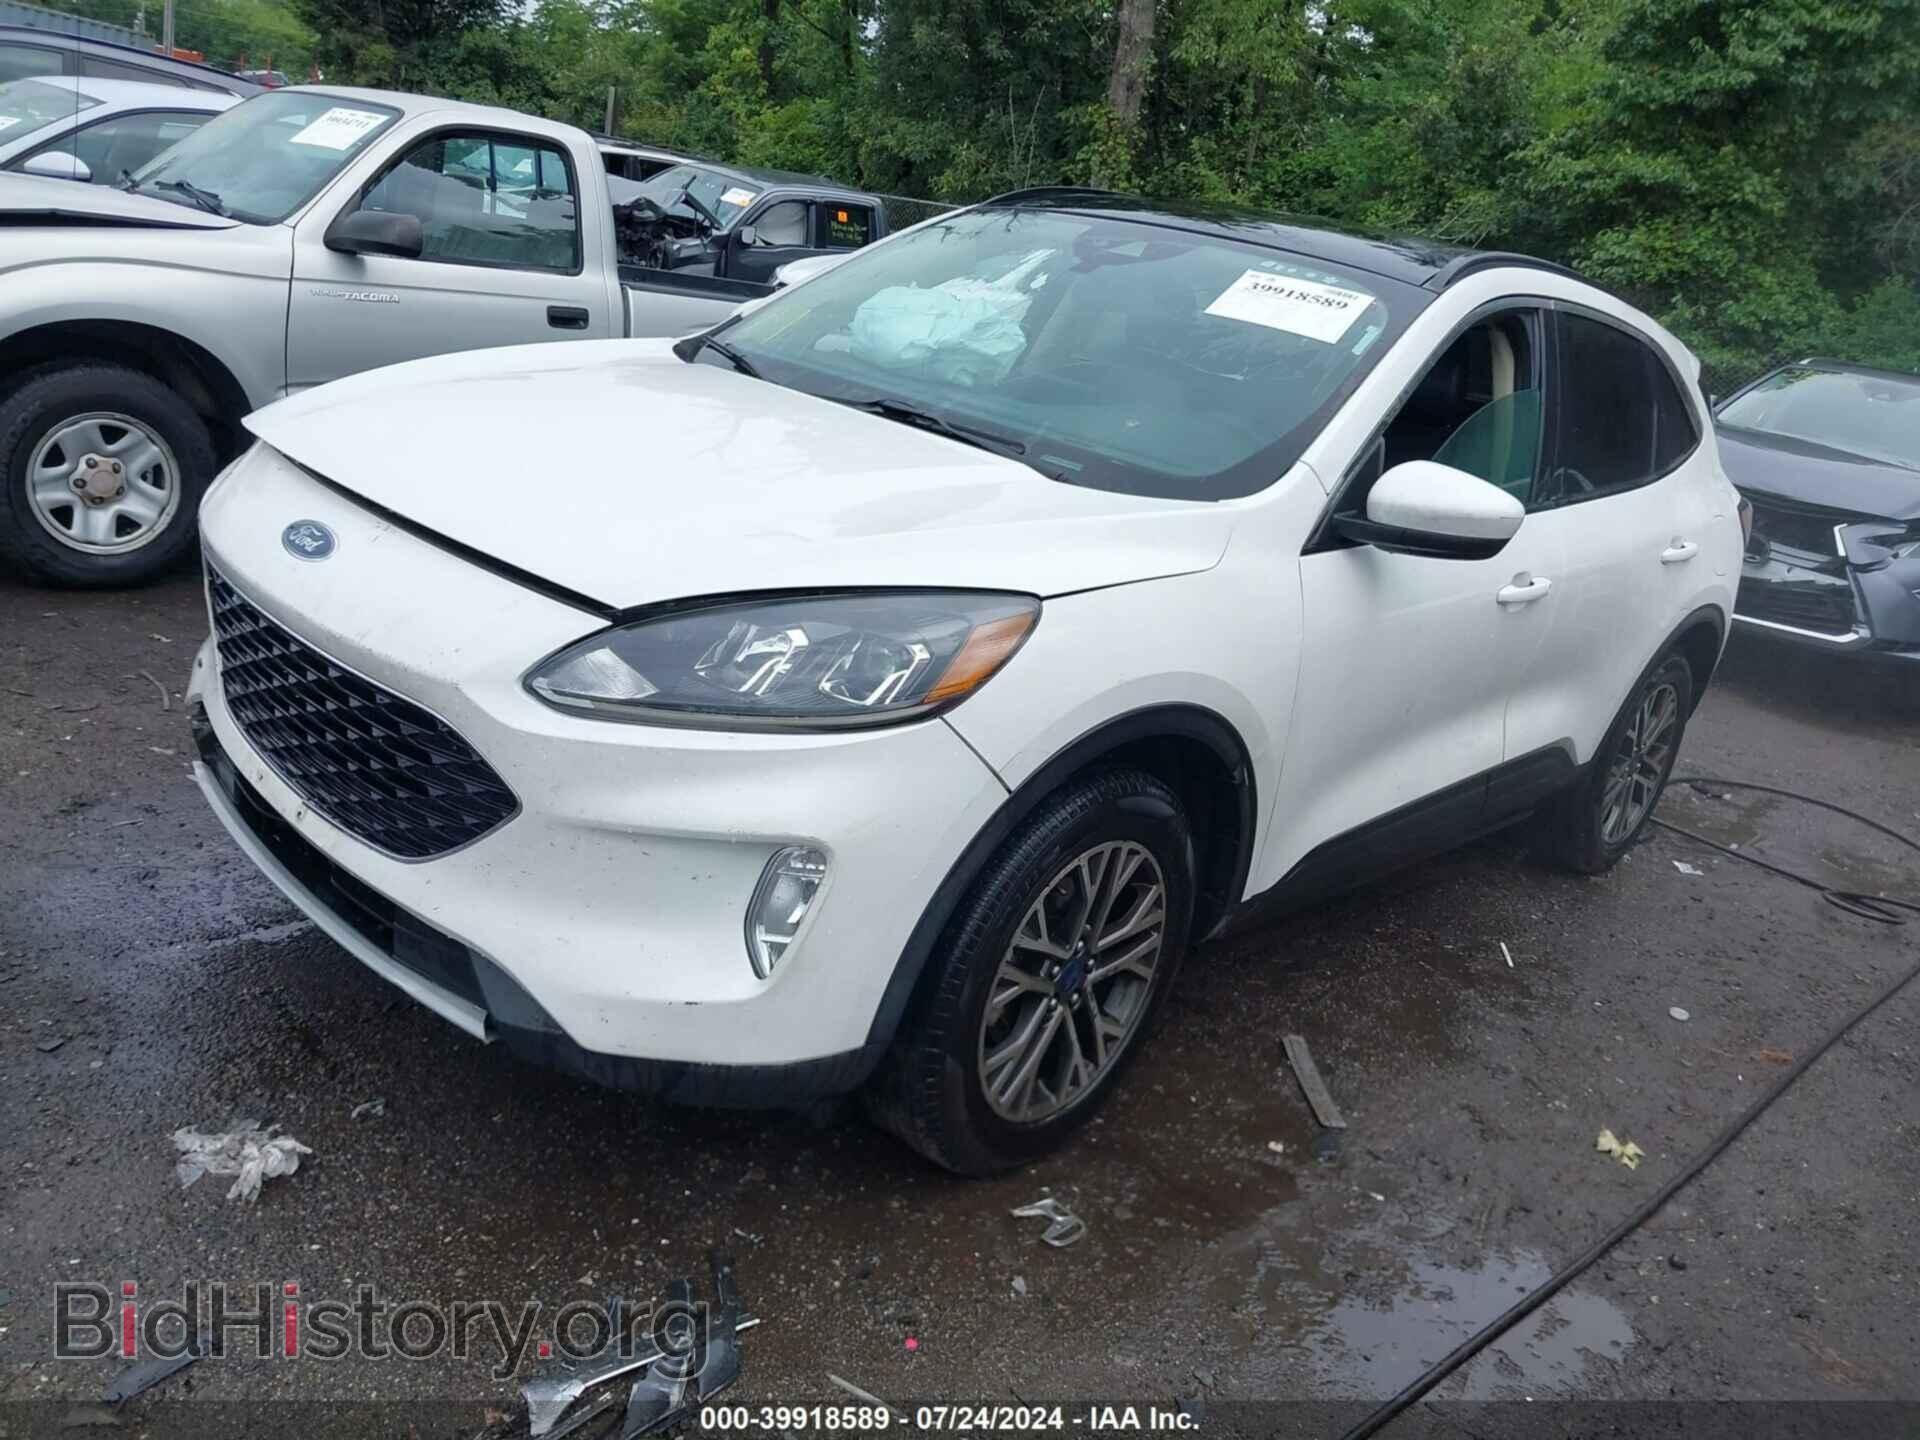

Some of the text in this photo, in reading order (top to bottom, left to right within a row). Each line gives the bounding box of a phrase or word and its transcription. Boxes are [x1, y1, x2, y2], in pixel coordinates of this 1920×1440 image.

[343, 292, 400, 303] TACOMA
[1252, 282, 1349, 309] 39918589
[288, 525, 325, 553] Ford
